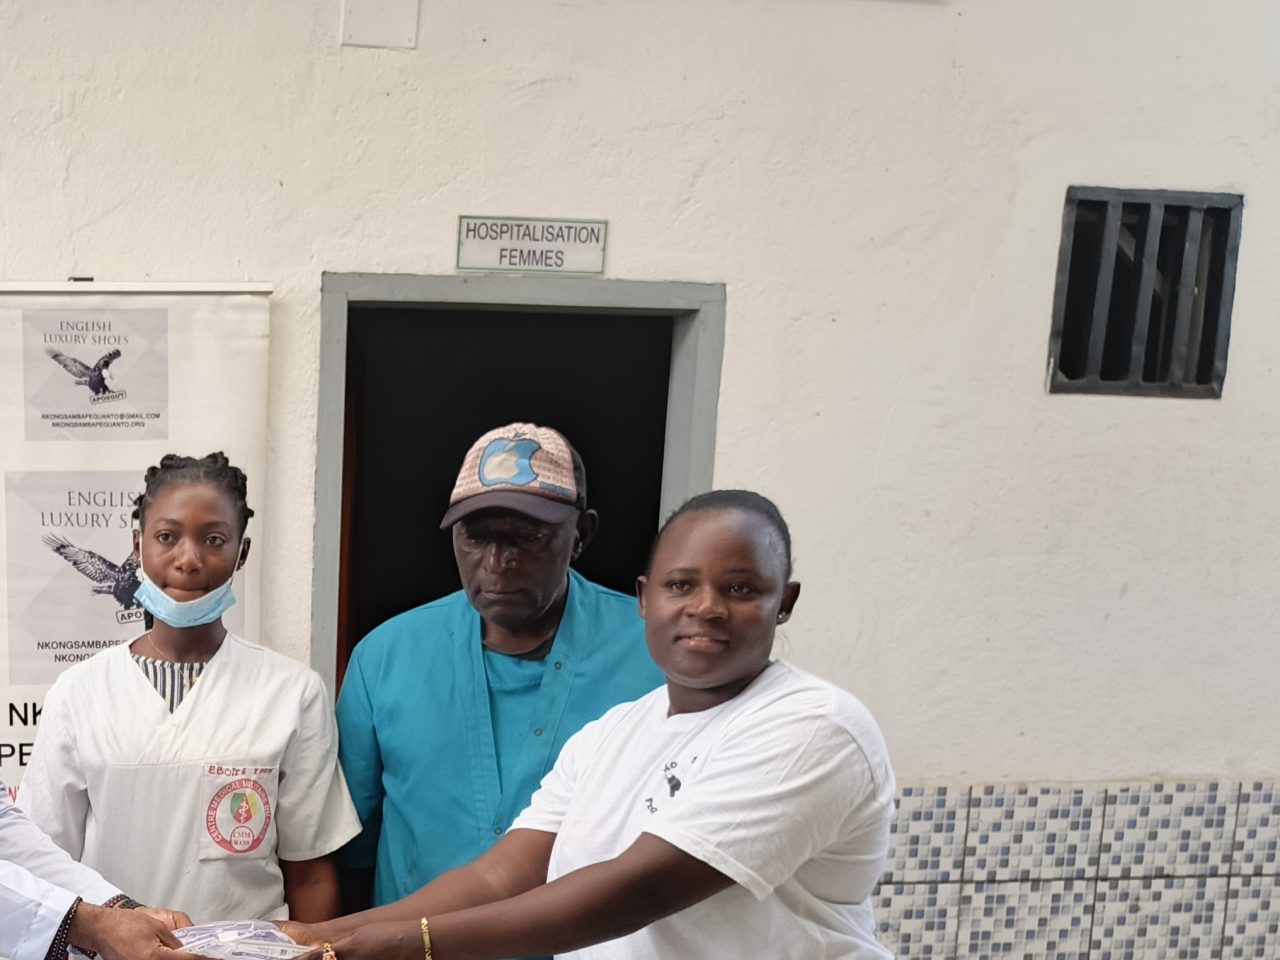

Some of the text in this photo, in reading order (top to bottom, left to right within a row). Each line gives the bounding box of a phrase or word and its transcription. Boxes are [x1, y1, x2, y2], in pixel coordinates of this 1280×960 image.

[466, 222, 601, 244] HOSPITALISATION
[499, 248, 564, 267] FEMMES
[60, 320, 112, 332] ENGLISH
[43, 333, 129, 346] LUXURY SHOES
[41, 512, 112, 528] LUXURY
